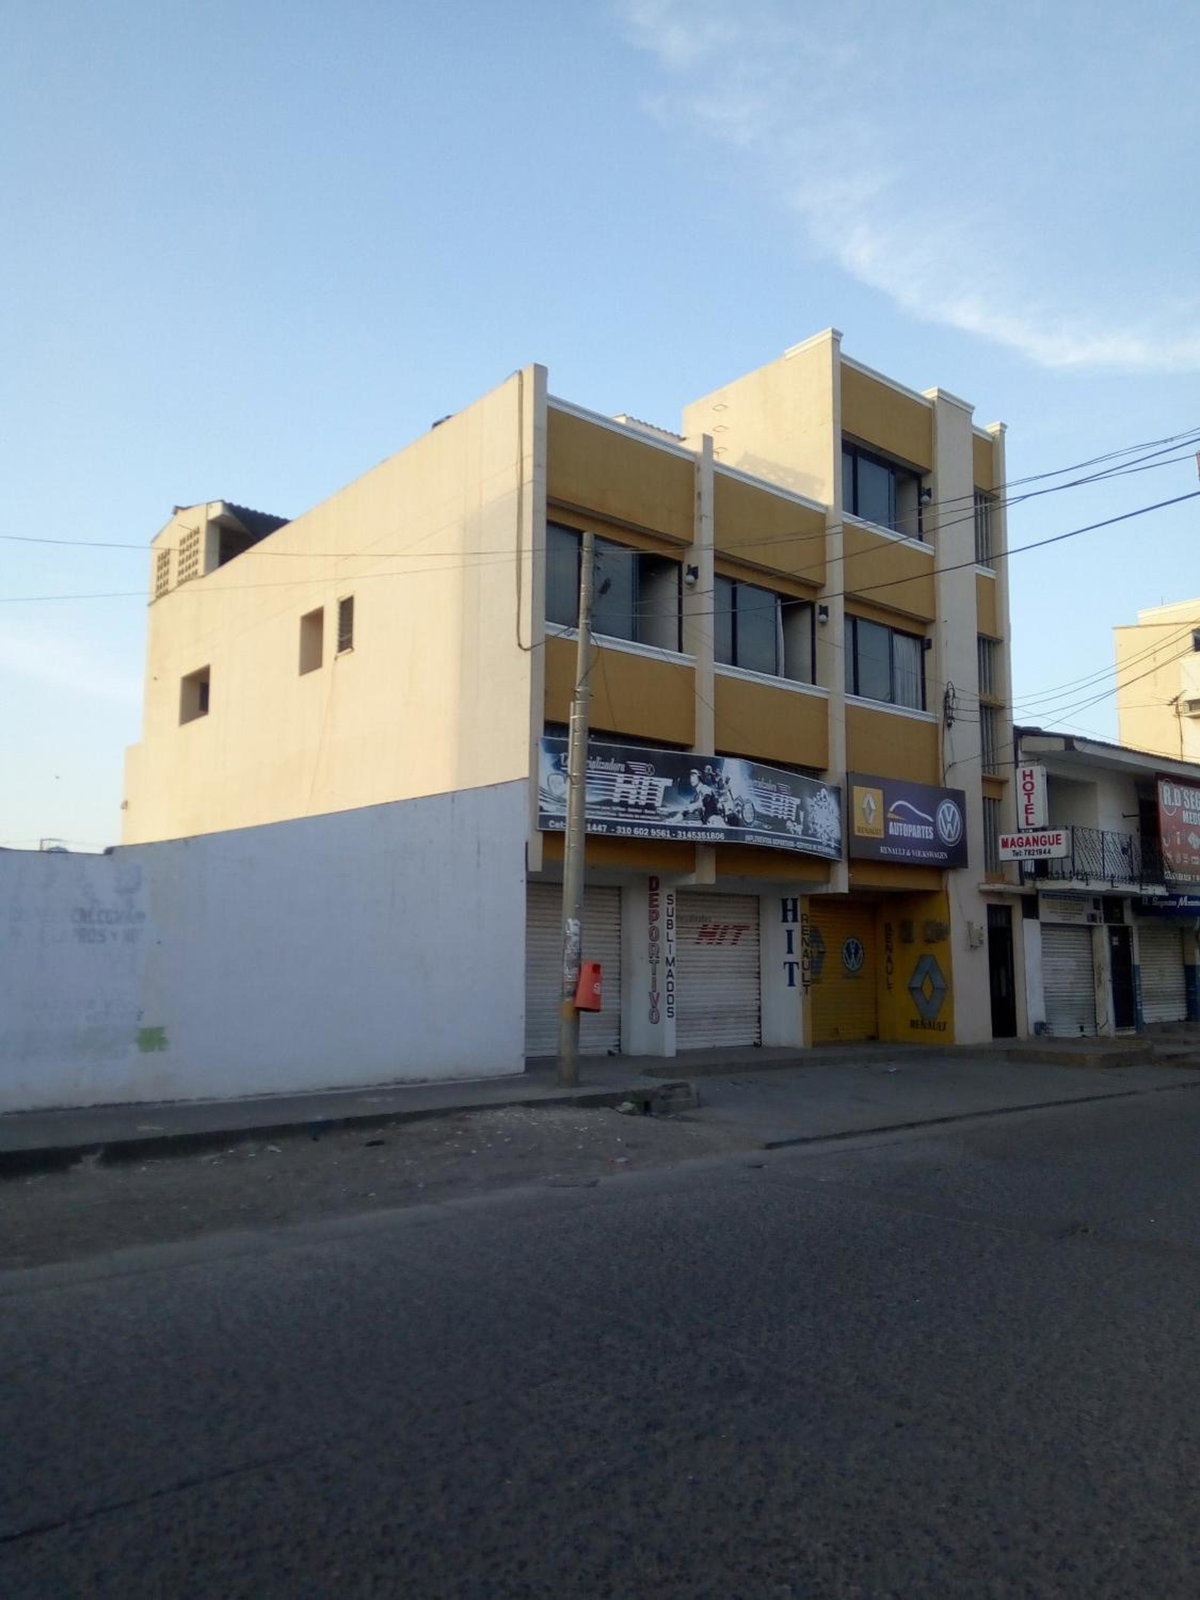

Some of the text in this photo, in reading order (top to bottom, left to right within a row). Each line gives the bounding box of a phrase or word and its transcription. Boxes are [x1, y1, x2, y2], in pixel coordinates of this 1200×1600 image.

[1022, 769, 1035, 827] HOTEL
[616, 826, 632, 835] 310
[633, 828, 649, 837] 602
[888, 821, 935, 840] AUTOPARTES
[1001, 834, 1062, 849] MAGANGUE
[648, 875, 661, 1025] DEPORTIVO
[693, 923, 752, 946] HIT
[781, 897, 800, 988] HIT
[800, 913, 813, 996] RENAULT
[665, 894, 676, 1018] SUBLIMADOS
[910, 1019, 948, 1033] RENAULT
